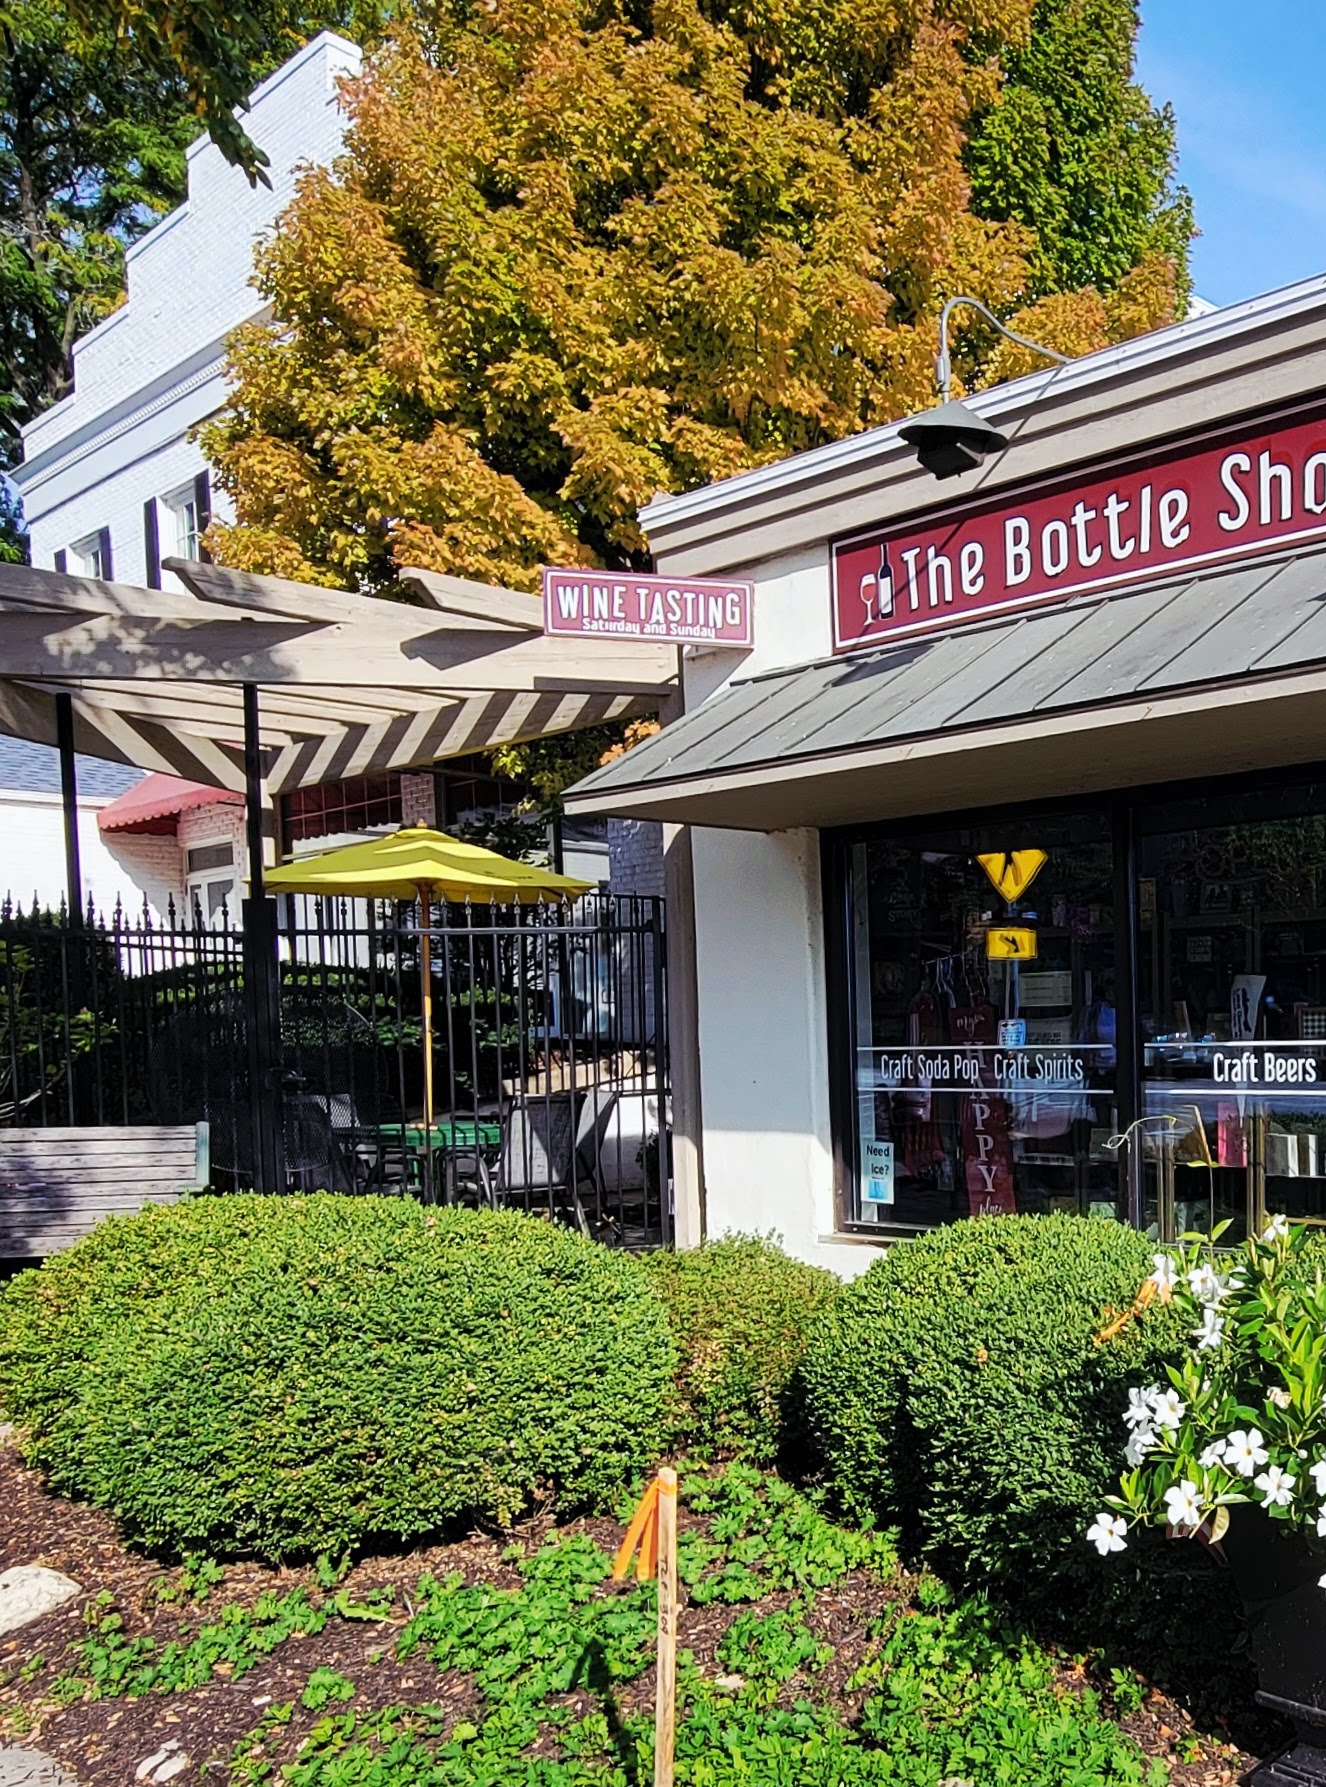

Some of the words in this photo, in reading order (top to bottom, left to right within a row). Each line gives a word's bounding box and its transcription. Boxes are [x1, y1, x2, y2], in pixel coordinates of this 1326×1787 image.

[901, 541, 986, 611] The
[1003, 484, 1191, 588] Bottle
[556, 584, 627, 619] WINE
[635, 587, 741, 629] TASTING
[582, 617, 640, 635] Saturday
[643, 620, 667, 636] and
[669, 623, 716, 639] Sunday
[881, 1053, 914, 1080] Craft
[917, 1052, 950, 1080] Soda
[954, 1054, 980, 1084] Pop
[993, 1053, 1031, 1080] Craft
[1035, 1052, 1084, 1084] Spirits
[1213, 1051, 1259, 1082] Craft
[1263, 1052, 1317, 1083] Beers
[866, 1144, 890, 1157] Need
[871, 1163, 890, 1176] Ice?
